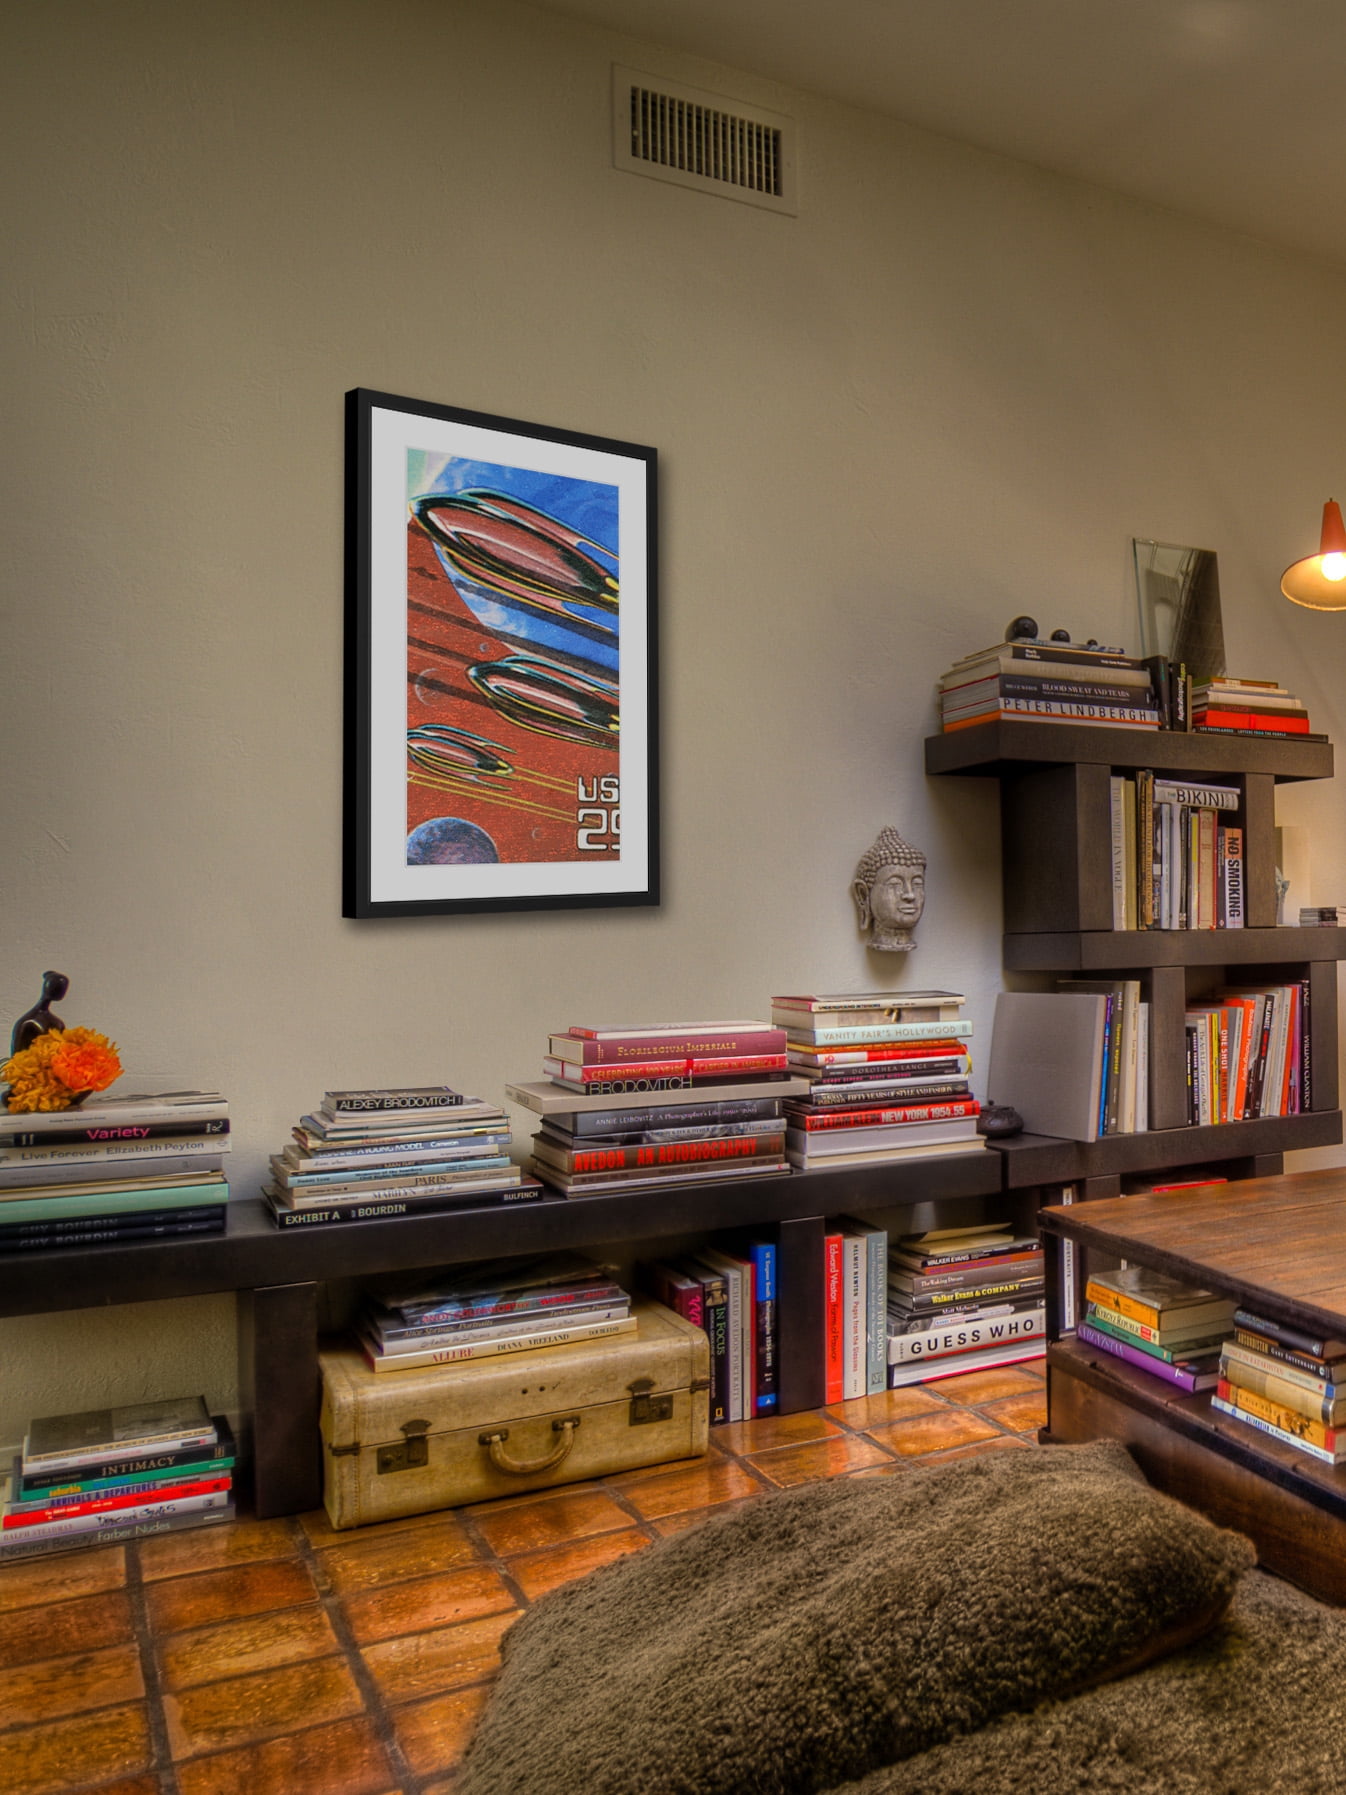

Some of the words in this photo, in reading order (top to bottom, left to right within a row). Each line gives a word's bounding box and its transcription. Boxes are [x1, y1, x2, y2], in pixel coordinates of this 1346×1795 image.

[1003, 698, 1053, 712] PETER
[1060, 703, 1146, 721] LINDBERGH
[577, 776, 619, 803] US
[1176, 789, 1225, 808] BIKINI
[1227, 836, 1240, 857] NO
[1227, 859, 1241, 918] SMOKING
[823, 1031, 857, 1041] VANITY
[861, 1029, 891, 1039] FAIR'S
[895, 1025, 957, 1036] HOLLYWOOD
[851, 1065, 899, 1075] DOROTHEA
[589, 1076, 693, 1096] BRODOVITCH
[339, 1098, 382, 1110] ALEXEY
[383, 1096, 456, 1108] BRODOVITCH
[881, 1109, 905, 1123] NEW
[905, 1108, 929, 1120] YORK
[85, 1127, 150, 1140] Variety
[21, 1152, 48, 1161] Live
[50, 1149, 100, 1159] Forever
[106, 1144, 162, 1155] Elizabeth
[164, 1141, 205, 1153] Peyton
[395, 1142, 425, 1151] MODEL
[574, 1149, 625, 1171] AVEDON
[636, 1146, 654, 1166] AN
[658, 1138, 758, 1164] AUTOBIOGRAPHY
[414, 1174, 448, 1187] PARIS
[284, 1211, 330, 1225] EXHIBIT
[331, 1210, 341, 1221] A
[357, 1204, 407, 1217] BOURDIN
[503, 1190, 539, 1201] BULFINCH
[829, 1243, 839, 1273] Edward
[926, 1256, 951, 1266] WALKER
[951, 1254, 970, 1263] EVANS
[876, 1263, 884, 1290] BOOK
[829, 1274, 840, 1303] Weston
[981, 1283, 1020, 1296] COMPANY
[540, 1294, 575, 1306] WOOD
[716, 1306, 726, 1320] IN
[715, 1321, 726, 1356] FOCUS
[876, 1328, 884, 1362] BOOKS
[910, 1329, 982, 1355] GUESS
[989, 1318, 1035, 1338] WHO
[431, 1347, 475, 1363] ALLURE
[497, 1341, 522, 1352] DIANA
[527, 1333, 570, 1346] VREELAND
[101, 1456, 176, 1477] INTIMACY
[50, 1492, 91, 1507] ARRIVALS
[103, 1481, 157, 1499] DEPARTURES
[97, 1527, 132, 1541] Farber
[135, 1521, 171, 1535] Nudes
